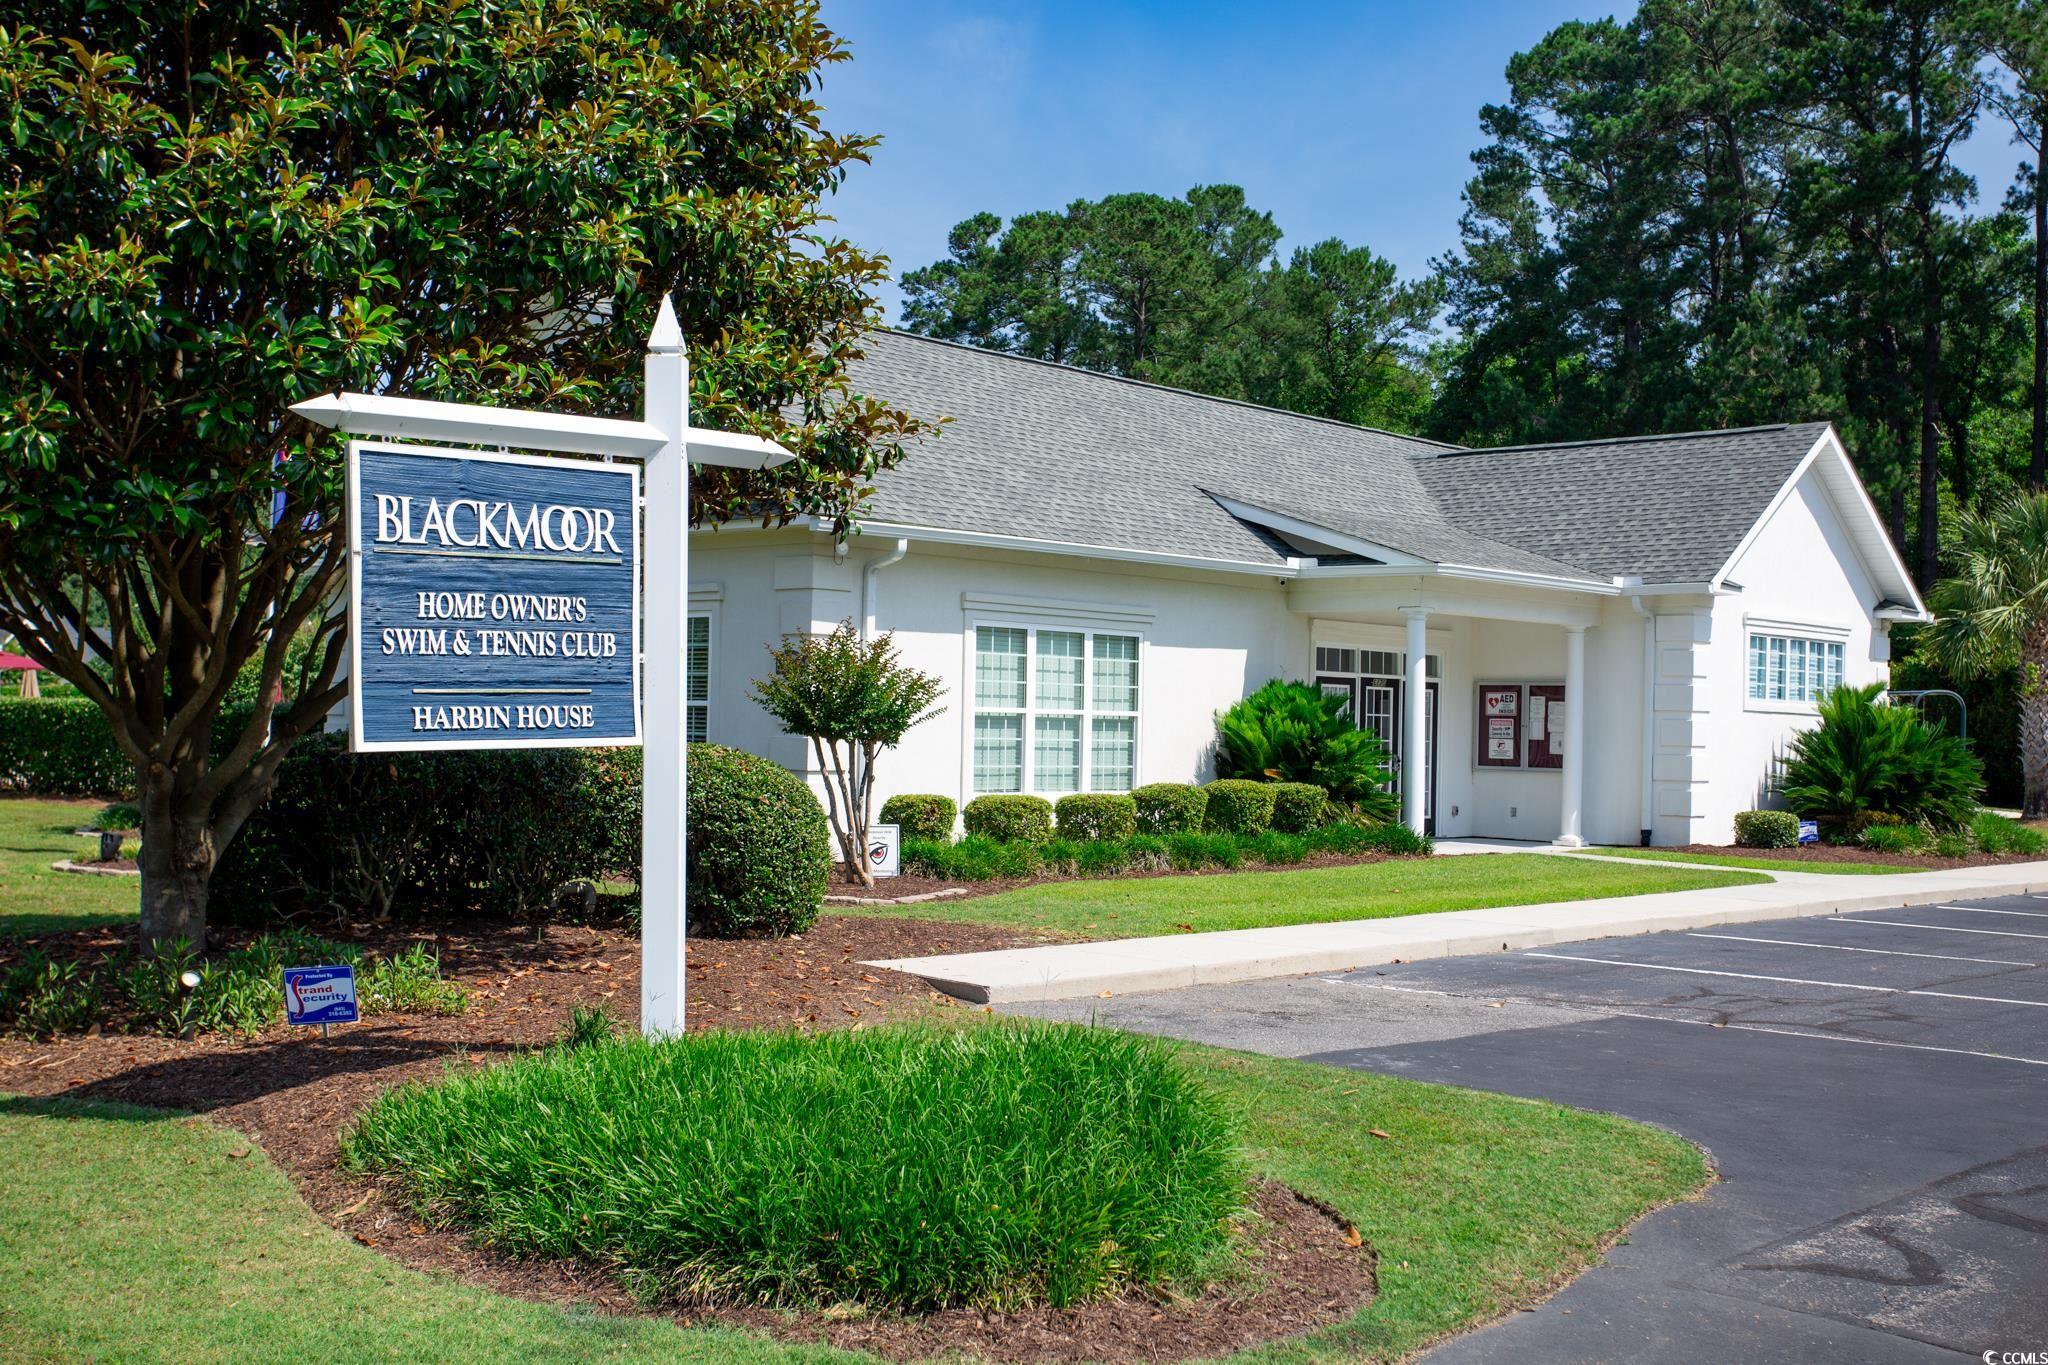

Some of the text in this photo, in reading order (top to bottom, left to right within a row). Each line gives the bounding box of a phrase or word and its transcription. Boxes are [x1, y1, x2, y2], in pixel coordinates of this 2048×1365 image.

[373, 493, 623, 554] BLACKMOOR
[417, 591, 587, 622] HOME OWNER'S
[382, 627, 617, 657] SWIM & TENNIS CLUB
[1500, 695, 1514, 703] AED
[412, 705, 594, 730] HARBIN HOUSE
